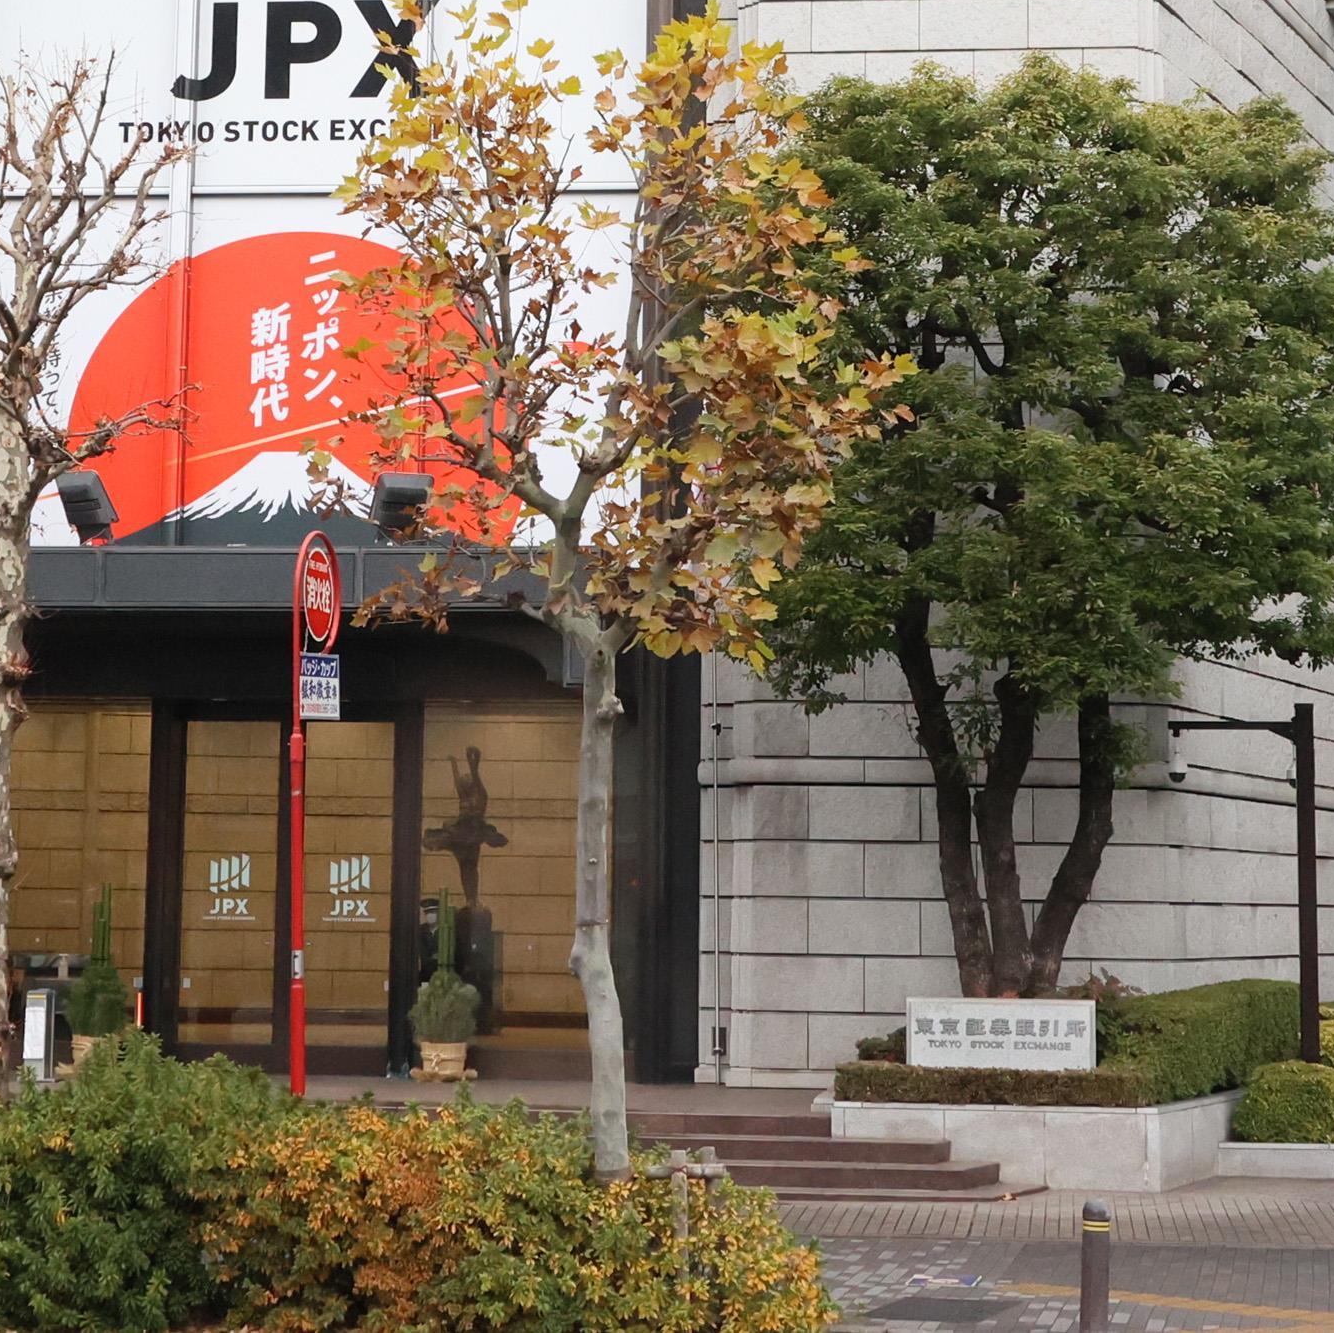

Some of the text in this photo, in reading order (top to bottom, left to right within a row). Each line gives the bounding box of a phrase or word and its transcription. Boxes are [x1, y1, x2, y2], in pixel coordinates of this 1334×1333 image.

[119, 120, 214, 143] TOKYO
[224, 119, 320, 143] STOCK
[301, 250, 343, 408] ニッポン、
[249, 302, 291, 427] 新時代
[306, 575, 332, 614] 消火栓
[210, 898, 249, 915] JPX
[330, 900, 369, 916] JPX
[927, 1039, 1071, 1051] TOKYO STOCK EXCHANGE
